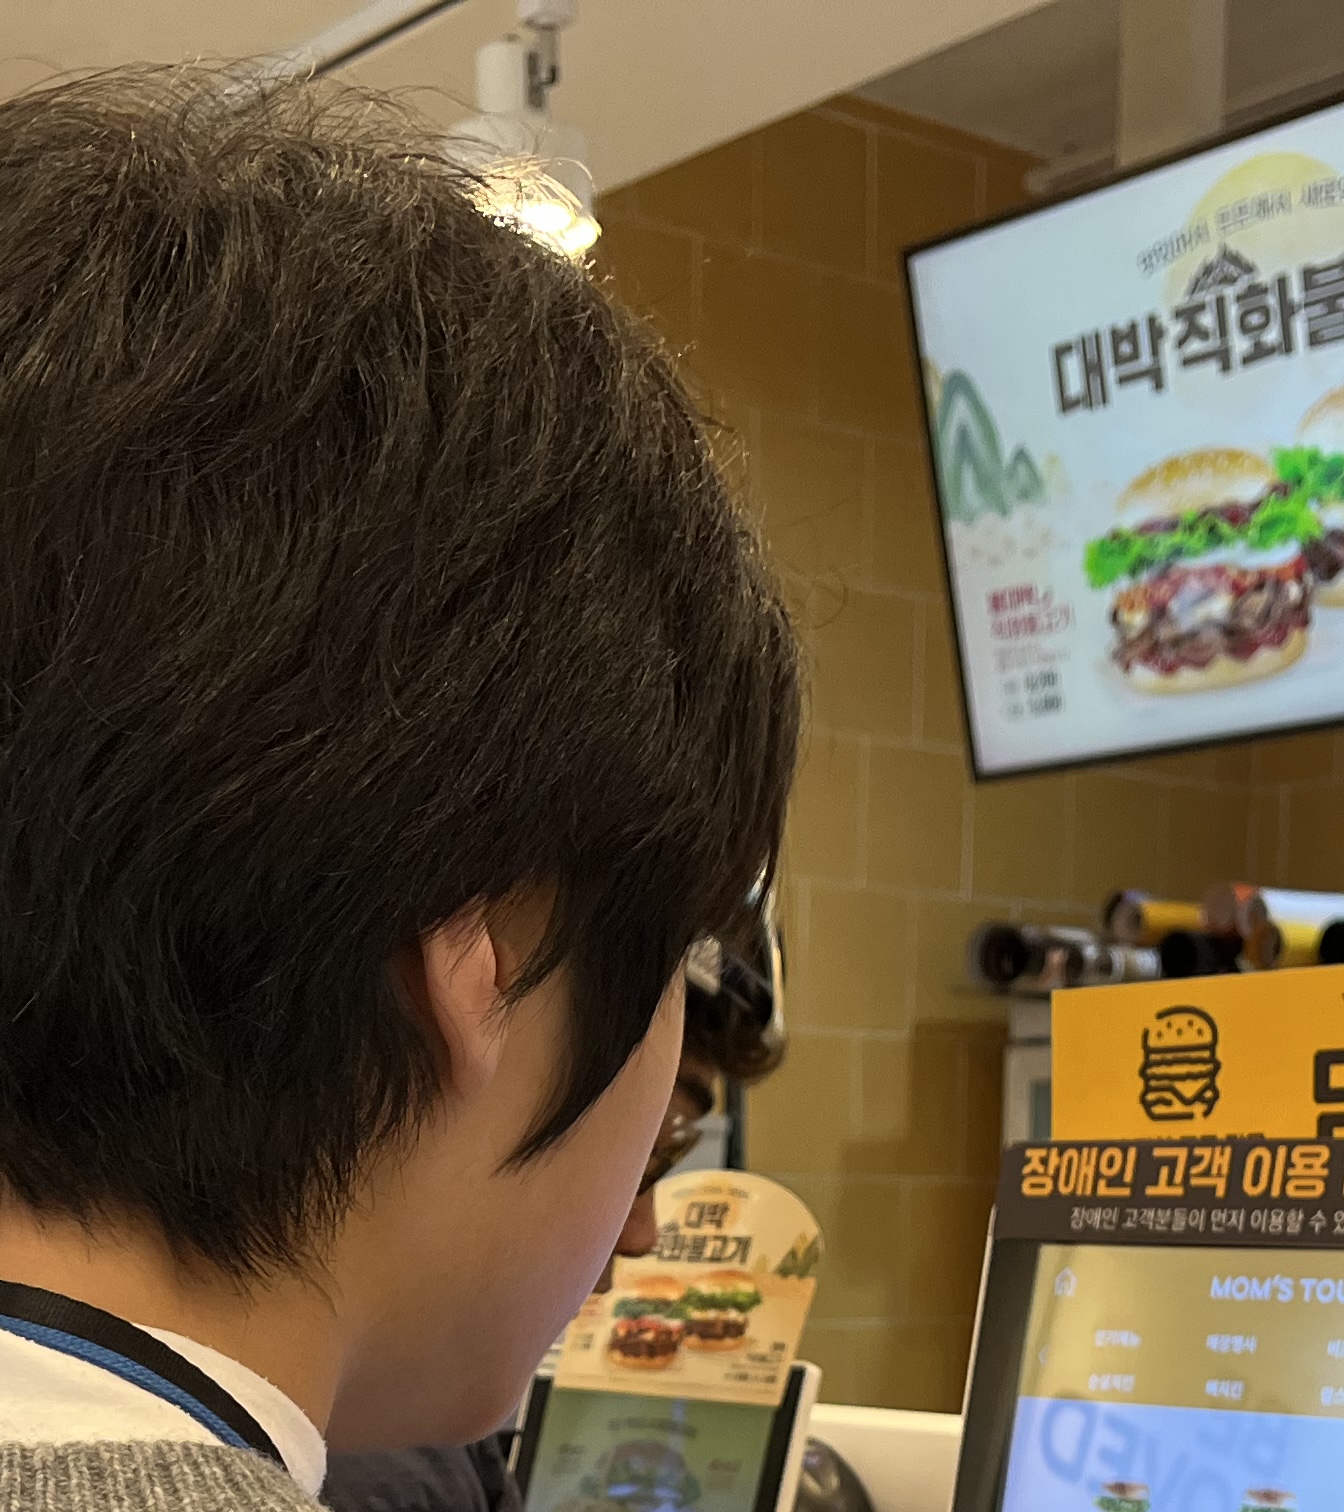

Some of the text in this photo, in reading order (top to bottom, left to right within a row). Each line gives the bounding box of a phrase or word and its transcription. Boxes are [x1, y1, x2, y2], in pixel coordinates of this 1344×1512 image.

[1020, 1145, 1137, 1198] 장애인
[1144, 1145, 1233, 1198] 고객
[1242, 1144, 1330, 1200] 이용
[1070, 1206, 1120, 1231] 장애인
[1122, 1207, 1205, 1233] 고객분들이
[1250, 1208, 1304, 1235] 이용할
[1309, 1210, 1327, 1235] 수
[654, 1231, 752, 1266] 화불고기
[1210, 1274, 1295, 1302] MOM'S
